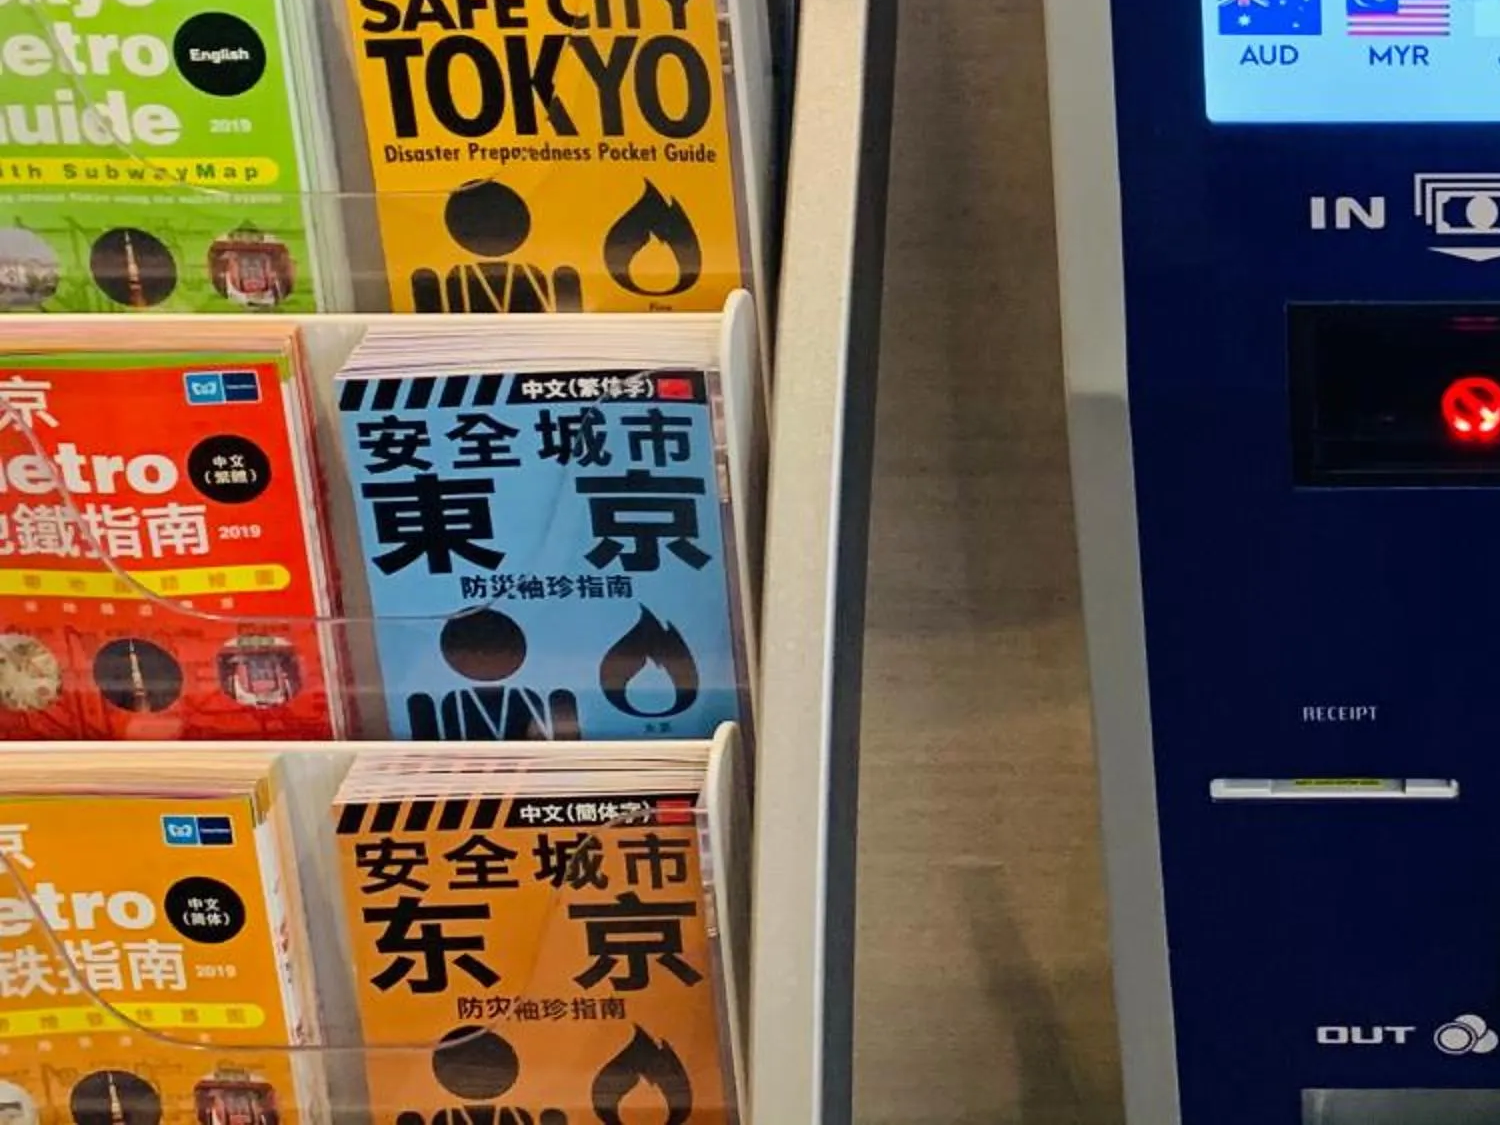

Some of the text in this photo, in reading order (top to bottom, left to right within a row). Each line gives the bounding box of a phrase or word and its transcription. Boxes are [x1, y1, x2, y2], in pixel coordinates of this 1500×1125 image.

[0, 21, 170, 77] etro
[189, 48, 250, 64] English
[1240, 45, 1299, 66] AUD
[1369, 45, 1430, 66] MYR
[364, 33, 712, 139] TOKYO
[0, 88, 182, 145] uide
[384, 144, 461, 163] Disaster
[599, 142, 658, 162] Pocket
[663, 143, 717, 163] Guide
[1310, 196, 1385, 229] IN
[356, 406, 693, 474] 安全城市
[0, 442, 179, 495] etro
[212, 454, 244, 468] 中文
[0, 502, 210, 558] 鐵指南
[218, 525, 262, 540] 2019
[361, 469, 713, 576] 東京
[1302, 706, 1379, 722] RECEIPT
[355, 833, 691, 895] 安全城市
[187, 898, 221, 911] 中文
[363, 891, 704, 994] 东京
[195, 964, 237, 978] 2019
[1316, 1026, 1416, 1044] OUT
